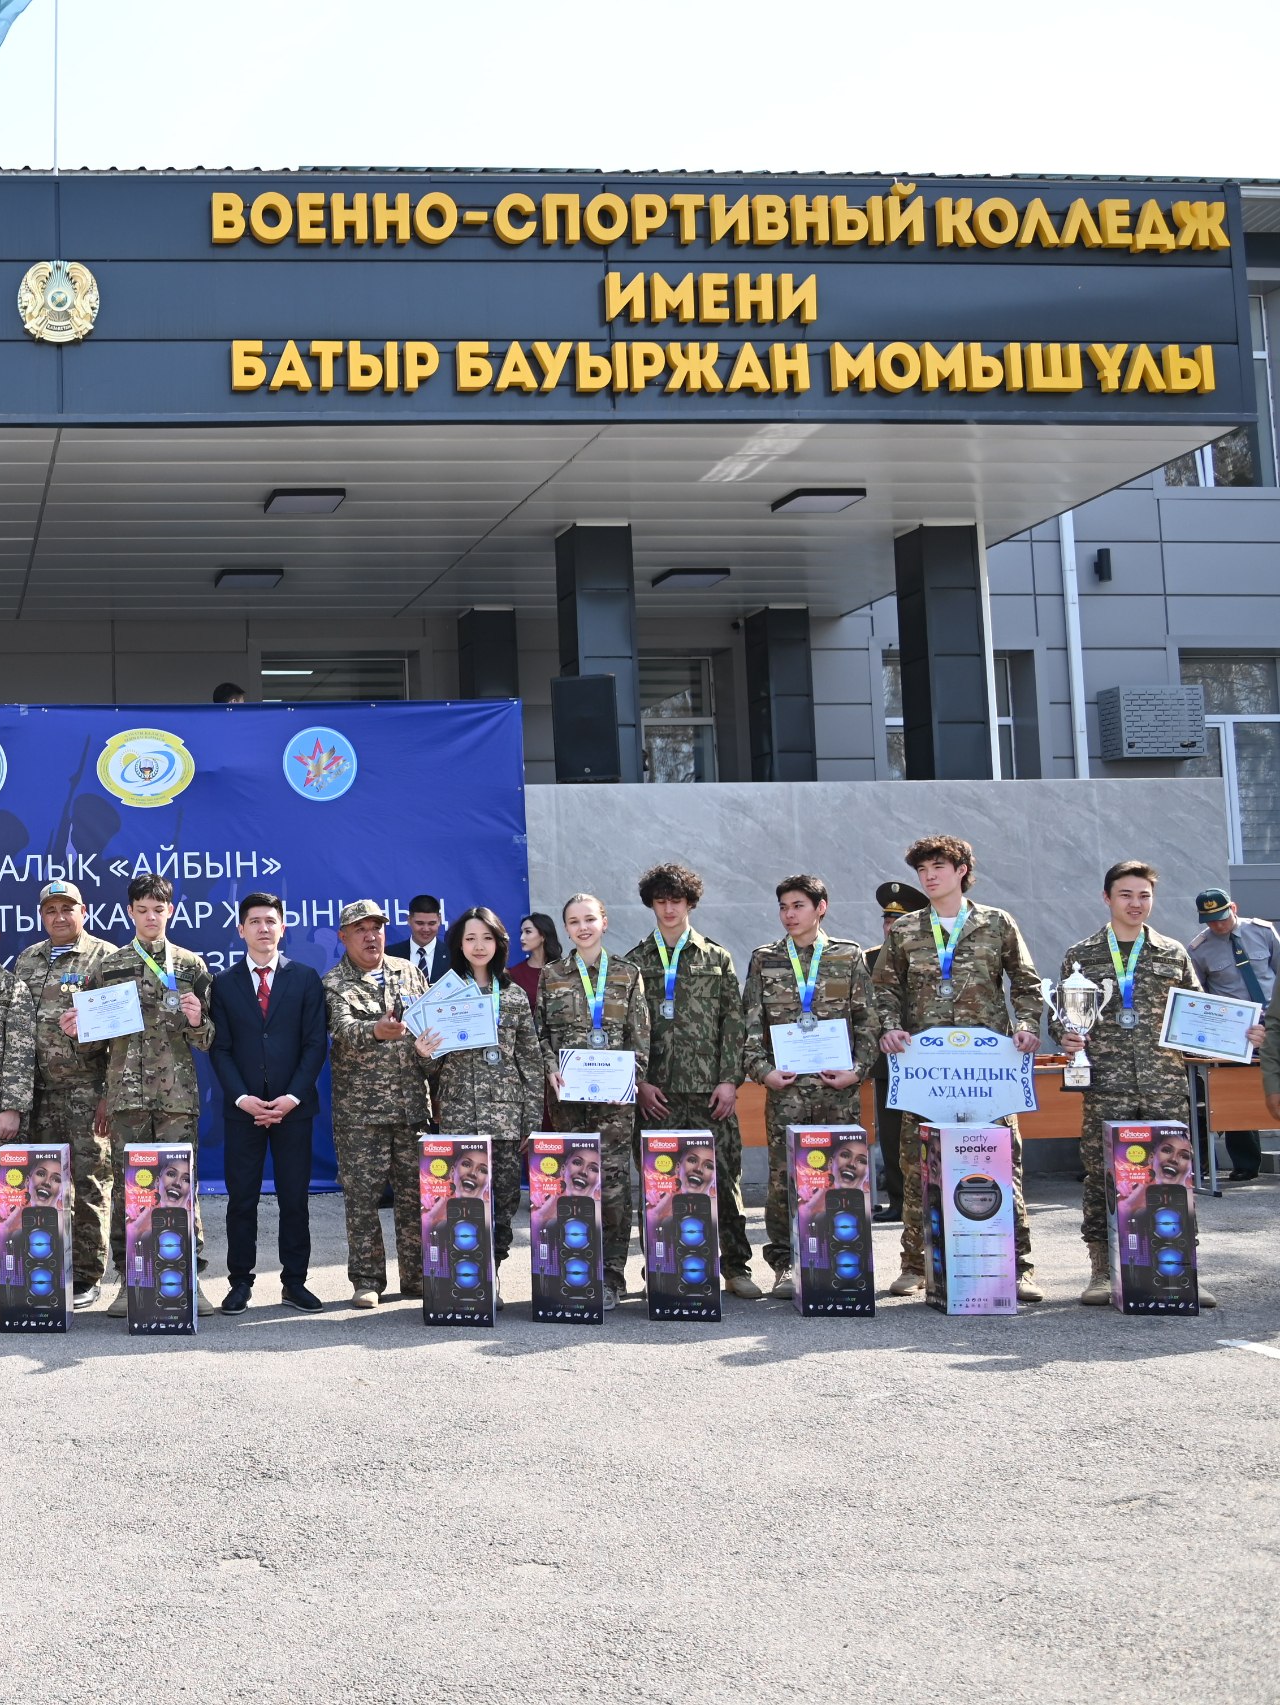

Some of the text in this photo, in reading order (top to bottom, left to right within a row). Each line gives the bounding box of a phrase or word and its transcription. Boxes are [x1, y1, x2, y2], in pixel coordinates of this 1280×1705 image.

[212, 183, 1231, 254] ВОЕННО-СПОРТИВНЫЙ КОЛЛЕДЖ
[605, 272, 818, 324] ИМЕНИ
[232, 339, 1216, 394] БАТЫР БАУЫРЖАН МОМЫШҰЛЫ
[109, 844, 282, 880] «АЙБЫН»
[84, 901, 213, 931] ЖААР
[904, 1066, 1018, 1083] БОСТАНДЫҚ
[928, 1086, 993, 1099] АУДАНЫ
[954, 1144, 998, 1154] speaker
[962, 1134, 988, 1143] party
